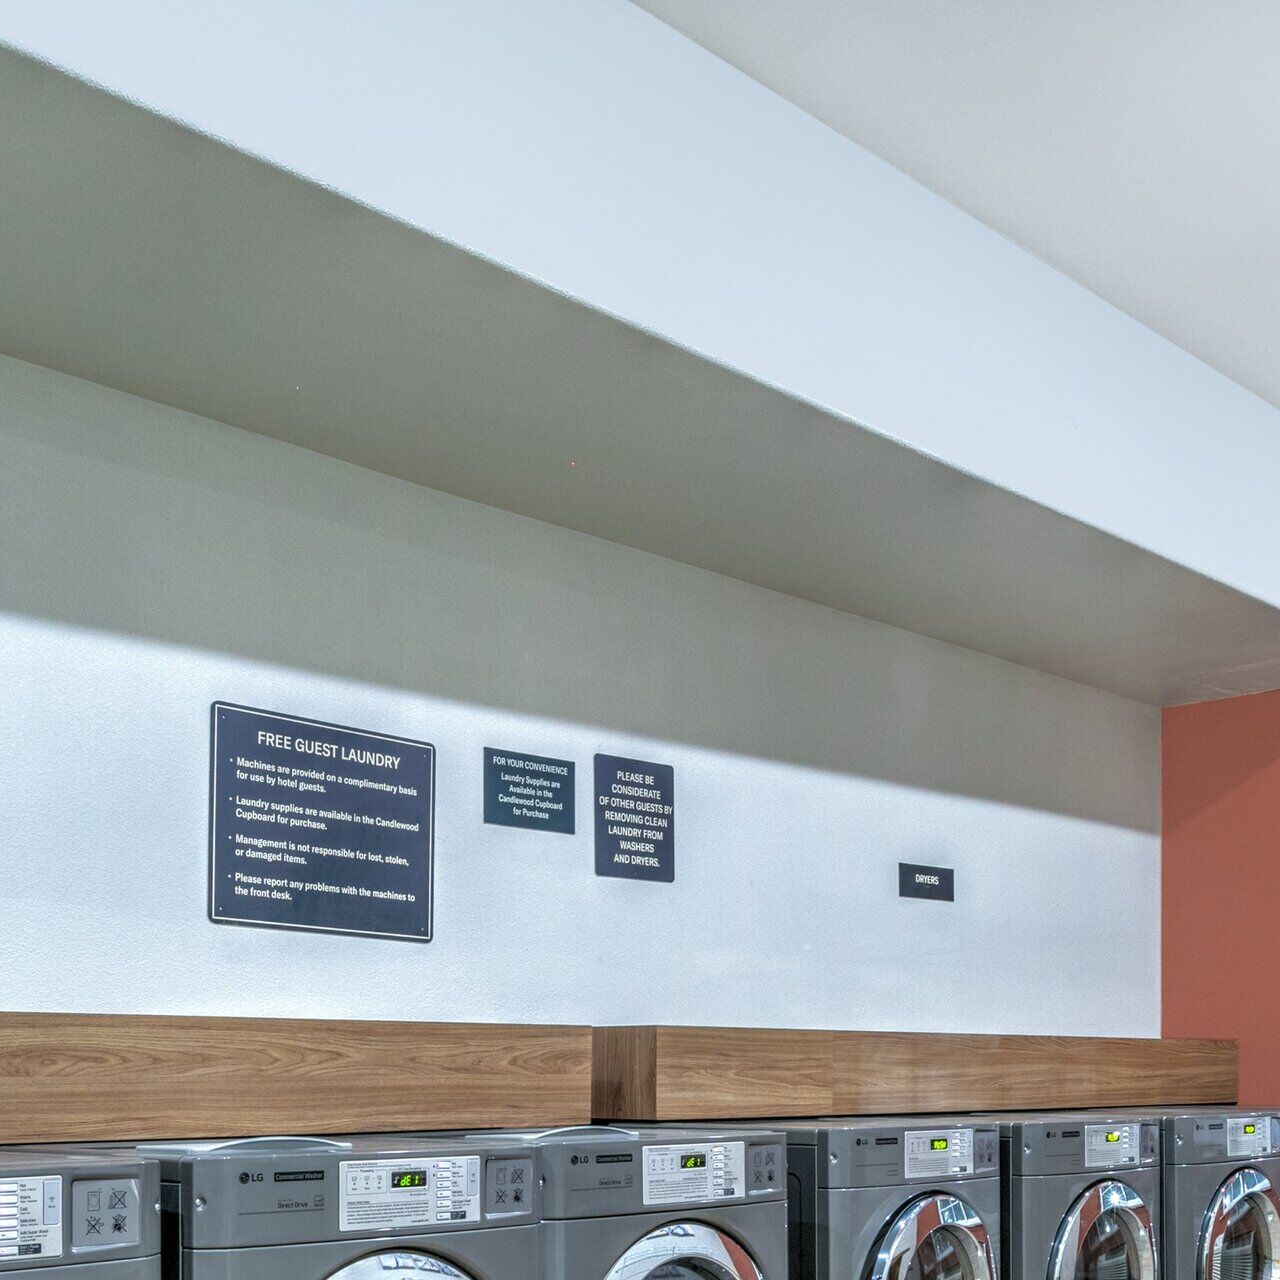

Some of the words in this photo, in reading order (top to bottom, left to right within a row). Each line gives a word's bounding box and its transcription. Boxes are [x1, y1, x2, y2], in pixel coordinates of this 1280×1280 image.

[258, 731, 292, 749] FREE
[295, 739, 339, 757] GUEST
[342, 747, 401, 769] LAUNDRY
[493, 756, 506, 765] FOR
[507, 759, 524, 768] YOUR
[525, 762, 568, 775] CONVENIENCE
[237, 757, 276, 771] Machines
[277, 766, 291, 774] are
[292, 769, 325, 780] provided
[344, 778, 398, 794] complimentary
[399, 785, 418, 796] basis
[237, 770, 249, 779] for
[250, 774, 265, 782] use
[267, 775, 277, 786] by
[278, 777, 298, 788] hotel
[299, 782, 327, 792] guests.
[501, 772, 526, 784] Laundry
[526, 776, 551, 787] Supplies
[617, 771, 644, 783] PLEASE
[645, 776, 655, 785] BE
[509, 785, 536, 795] Available
[543, 790, 553, 798] the
[612, 784, 661, 799] CONSIDERATE
[499, 794, 535, 806] Candlewood
[535, 799, 563, 810] Cupboard
[599, 796, 610, 805] OF
[611, 798, 635, 809] OTHER
[636, 801, 664, 813] GUESTS
[664, 806, 673, 814] BY
[236, 809, 276, 822] Cupboard
[277, 814, 289, 824] for
[290, 819, 328, 830] purchase.
[237, 796, 270, 810] Laundry
[271, 803, 304, 814] supplies
[305, 808, 318, 816] are
[319, 811, 353, 821] available
[354, 814, 361, 822] in
[362, 816, 375, 824] the
[376, 817, 419, 831] Candlewood
[513, 807, 522, 815] for
[523, 809, 550, 819] Purchase
[605, 811, 644, 824] REMOVING
[645, 816, 668, 827] CLEAN
[609, 825, 642, 837] LAUNDRY
[644, 830, 664, 840] FROM
[236, 834, 288, 849] Management
[289, 841, 296, 850] is
[312, 847, 355, 858] responsible
[356, 851, 367, 859] for
[368, 852, 384, 863] lost,
[385, 856, 410, 866] stolen,
[620, 841, 655, 852] WASHERS
[246, 849, 282, 862] damaged
[284, 853, 308, 864] items.
[614, 854, 631, 863] AND
[632, 856, 661, 866] DRYERS.
[235, 873, 263, 888] Please
[264, 878, 289, 889] report
[290, 881, 304, 890] any
[305, 882, 341, 893] problems
[342, 886, 358, 895] with
[359, 888, 372, 896] the
[373, 891, 407, 901] machines
[916, 874, 940, 885] DRYERS
[235, 886, 249, 895] the
[250, 888, 270, 897] front
[271, 890, 293, 900] desk.
[580, 1156, 589, 1164] LG
[252, 1173, 264, 1182] LG
